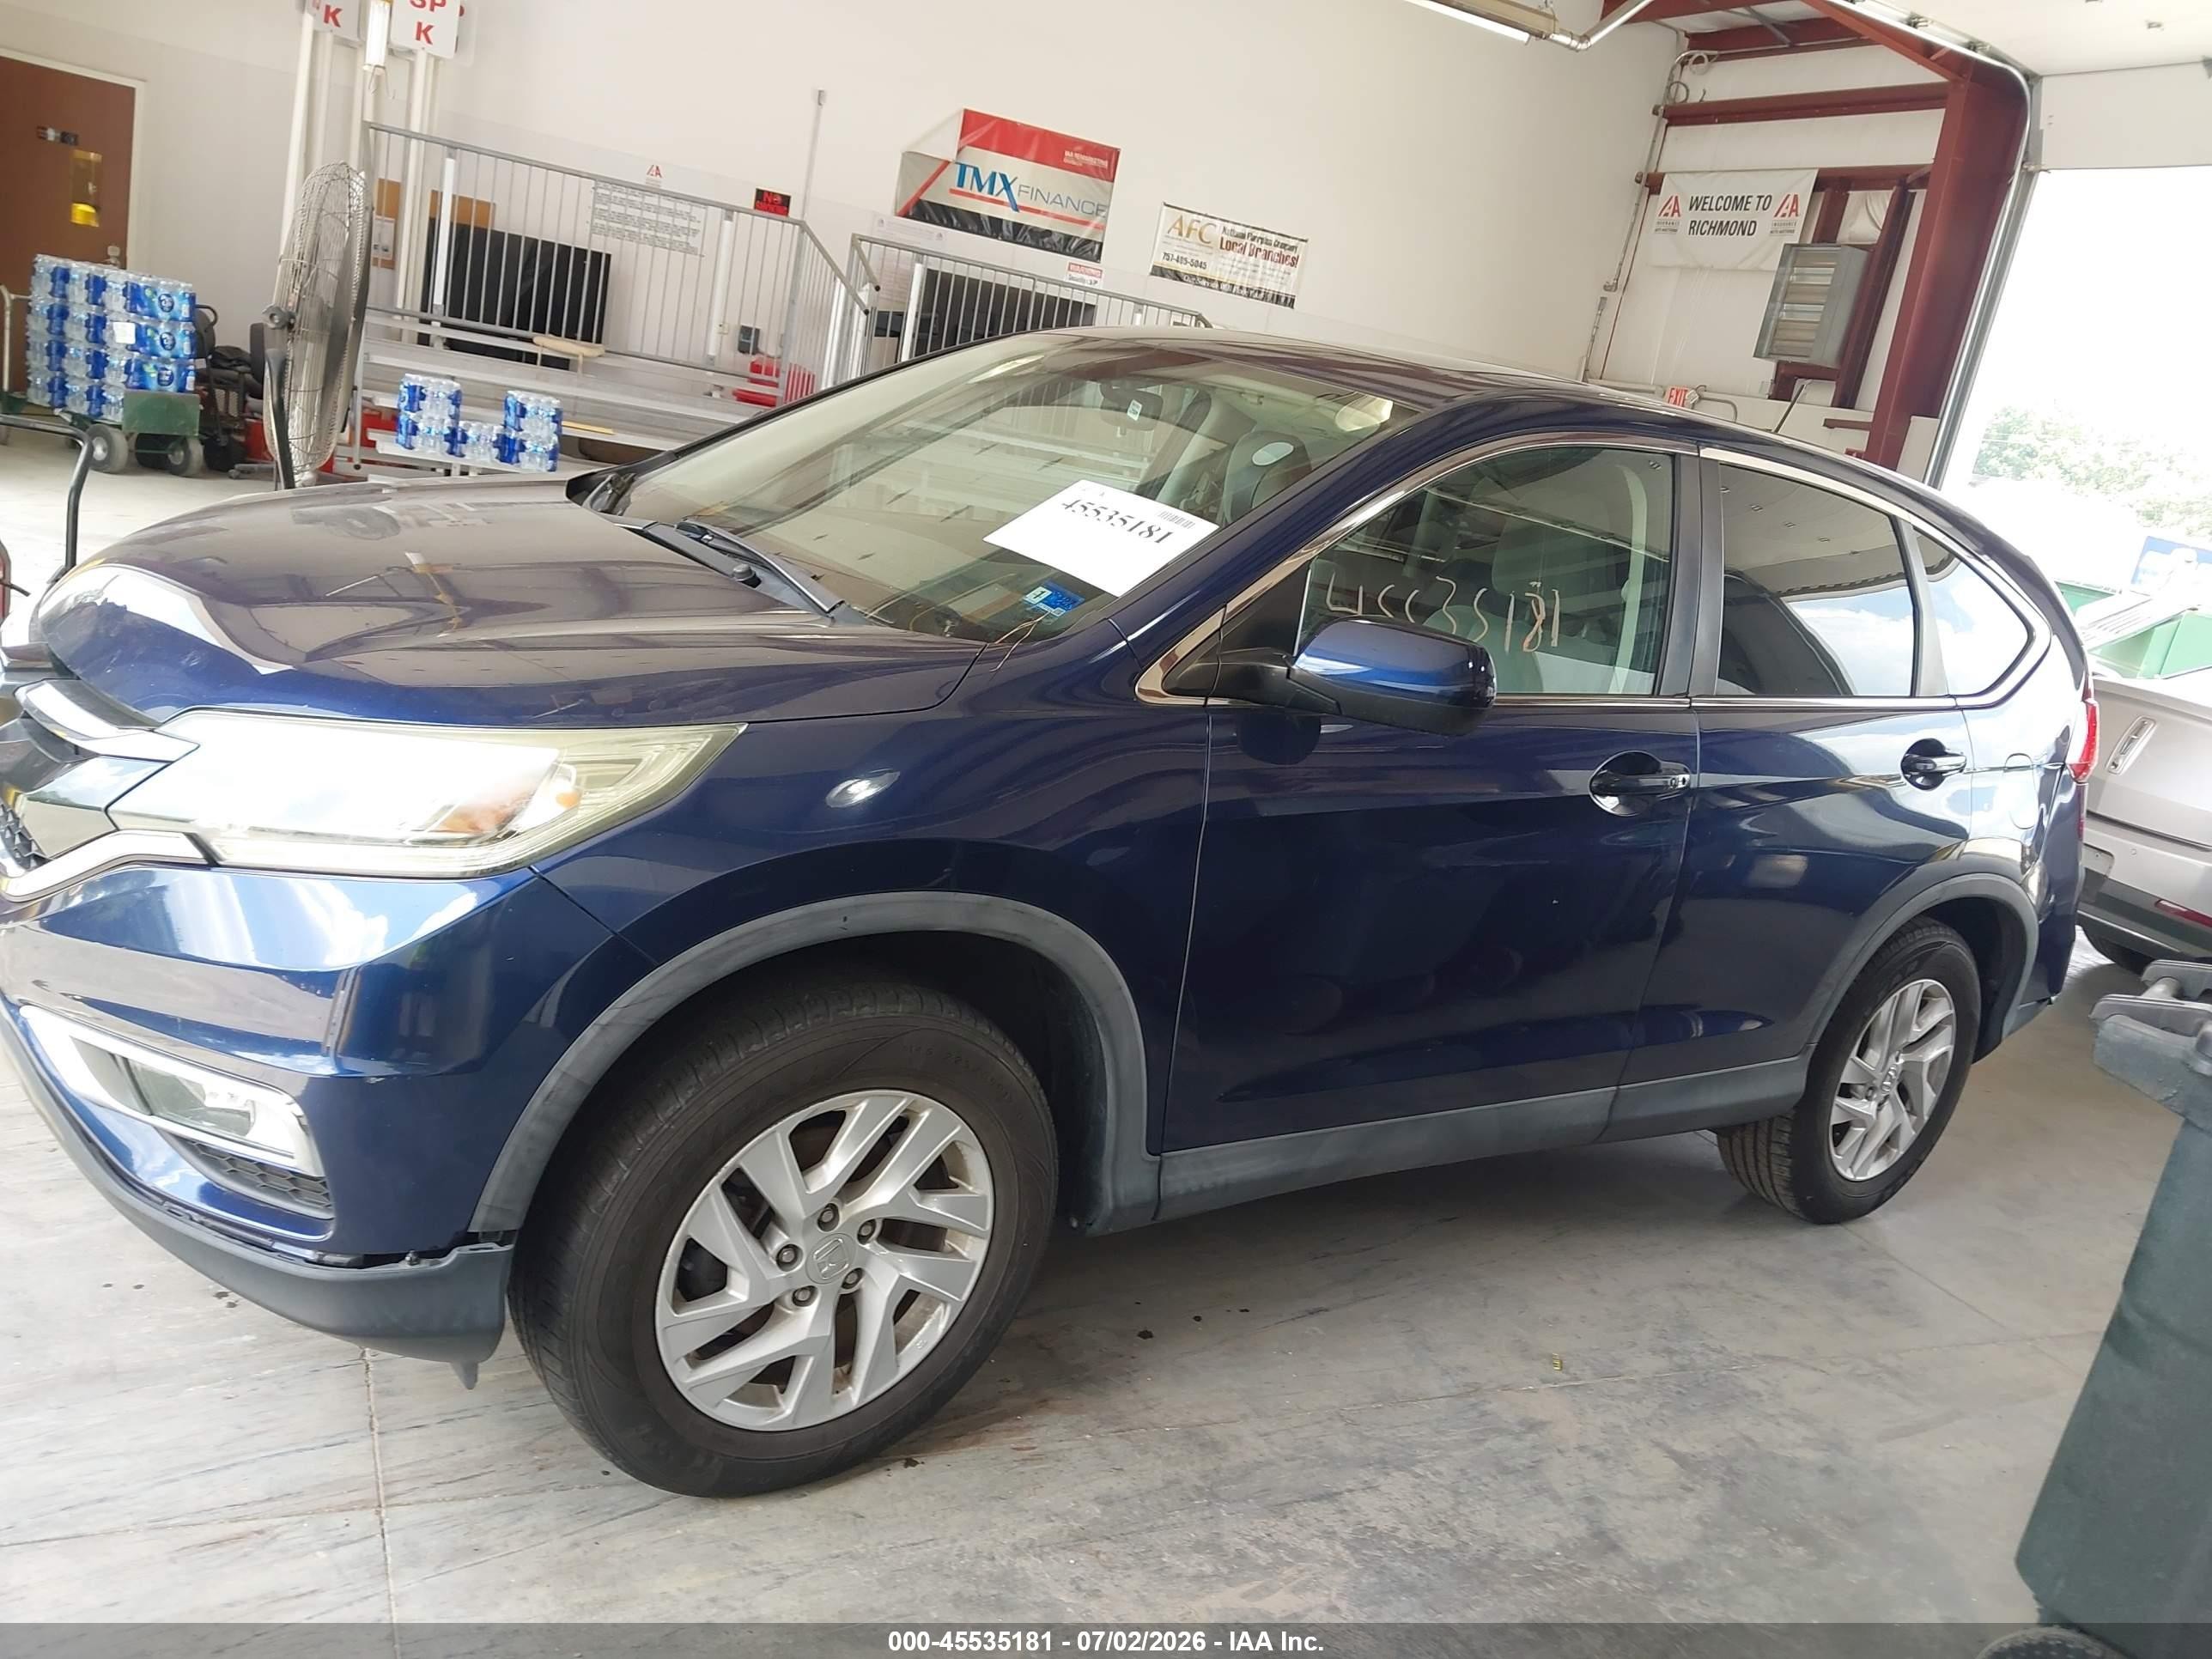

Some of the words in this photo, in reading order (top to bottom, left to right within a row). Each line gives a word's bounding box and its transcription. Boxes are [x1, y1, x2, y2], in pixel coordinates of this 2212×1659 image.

[415, 21, 434, 45] K
[955, 161, 1019, 213] TMX
[1018, 184, 1109, 218] FINANCE
[1688, 194, 1753, 211] WELCOME
[1755, 194, 1772, 211] TO
[1167, 214, 1217, 245] AFC
[1688, 220, 1758, 236] RICHMOND
[1219, 236, 1248, 256] Local
[1248, 242, 1300, 269] Branches!
[1668, 387, 1689, 408] EXIT
[1062, 499, 1175, 544] 45535181
